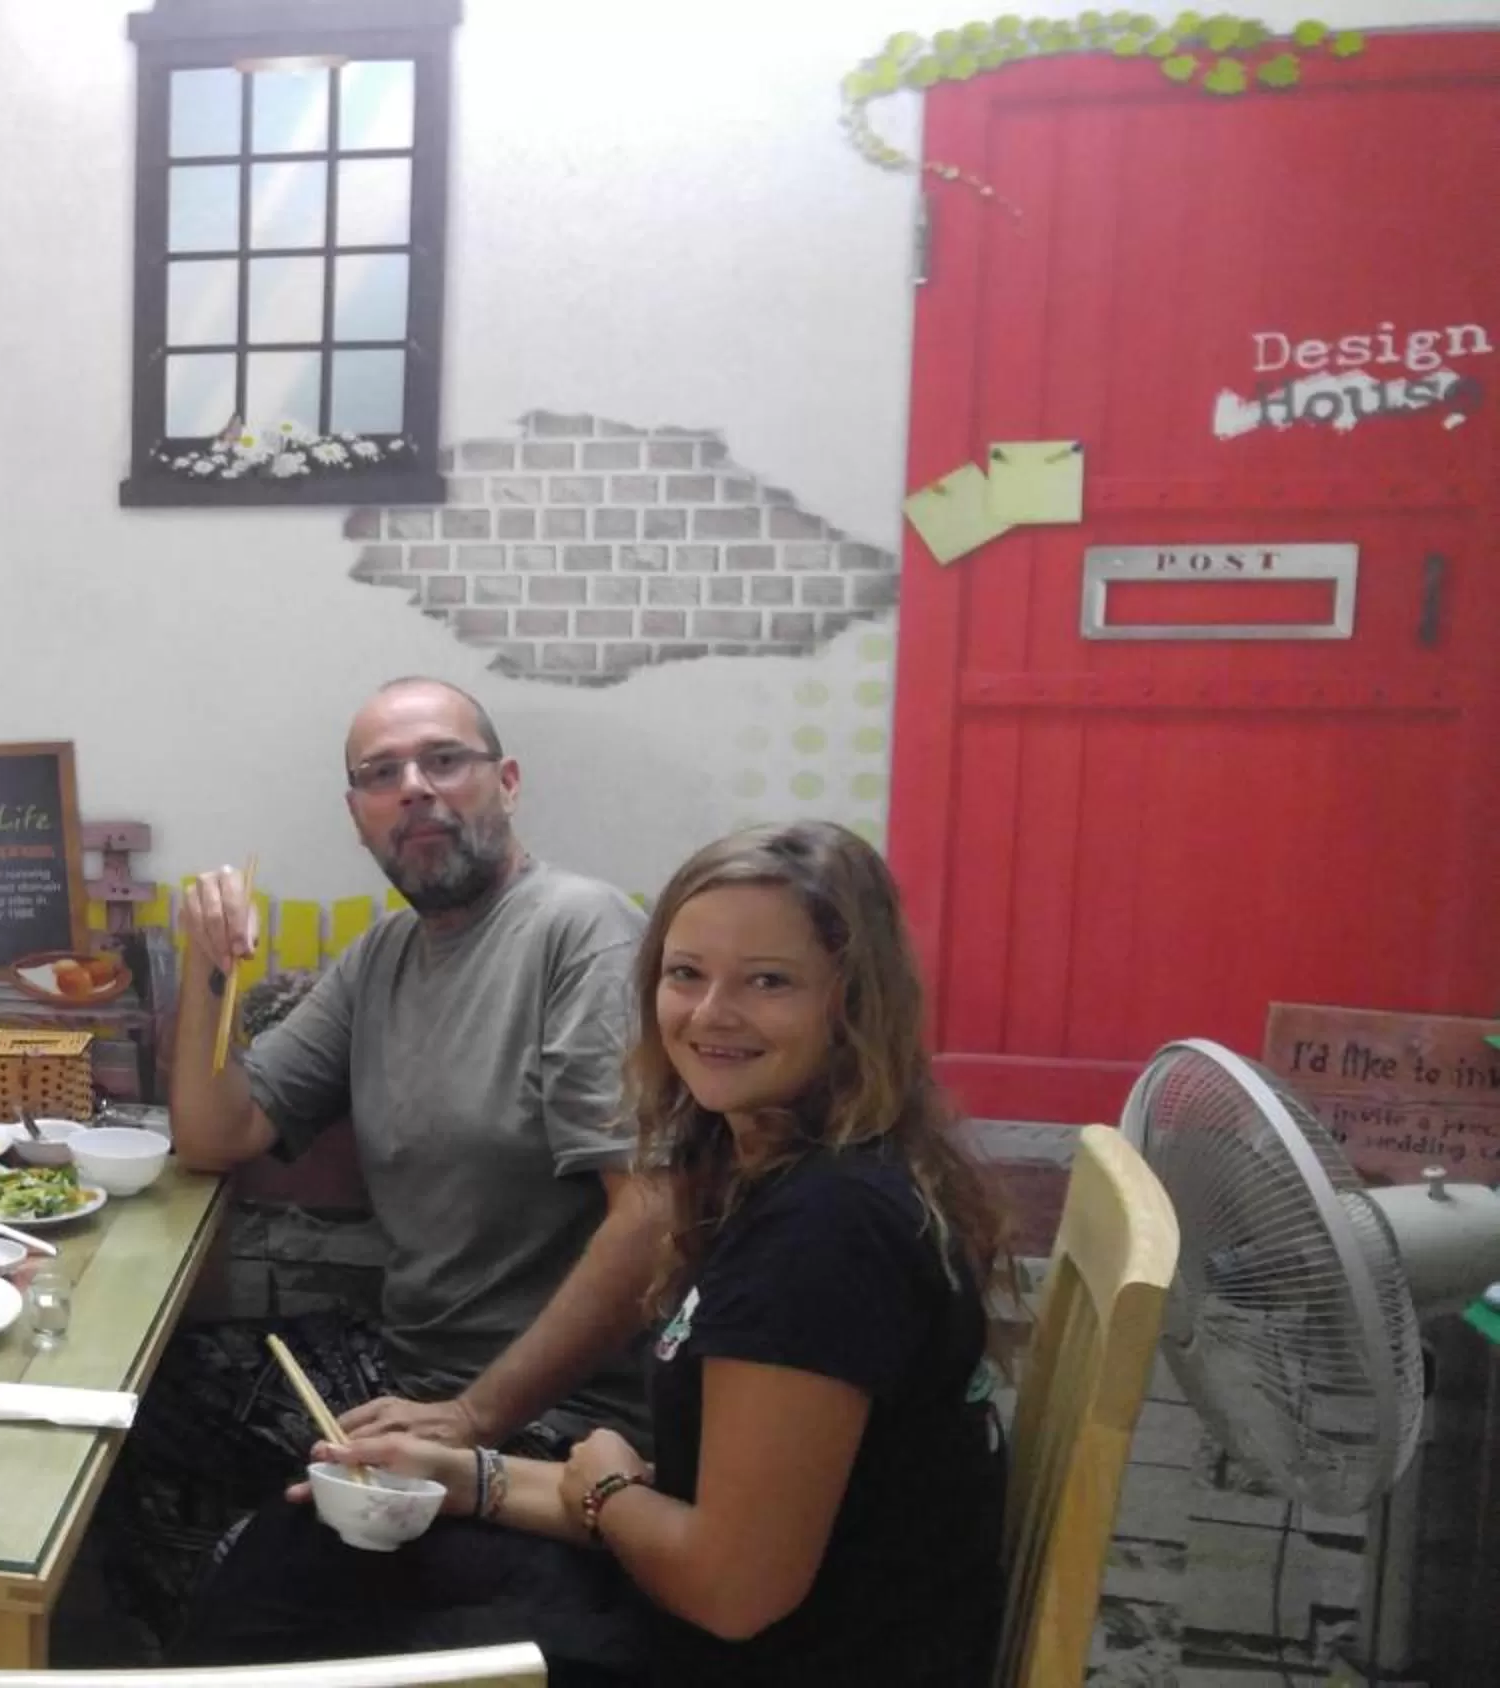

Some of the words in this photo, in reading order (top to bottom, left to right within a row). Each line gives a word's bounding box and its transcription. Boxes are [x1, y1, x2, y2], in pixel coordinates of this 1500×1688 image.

[1252, 321, 1493, 372] Design
[1257, 376, 1484, 427] House
[1155, 551, 1282, 572] POST
[1291, 1040, 1329, 1073] I'd
[1342, 1038, 1397, 1081] like
[1414, 1055, 1441, 1084] to
